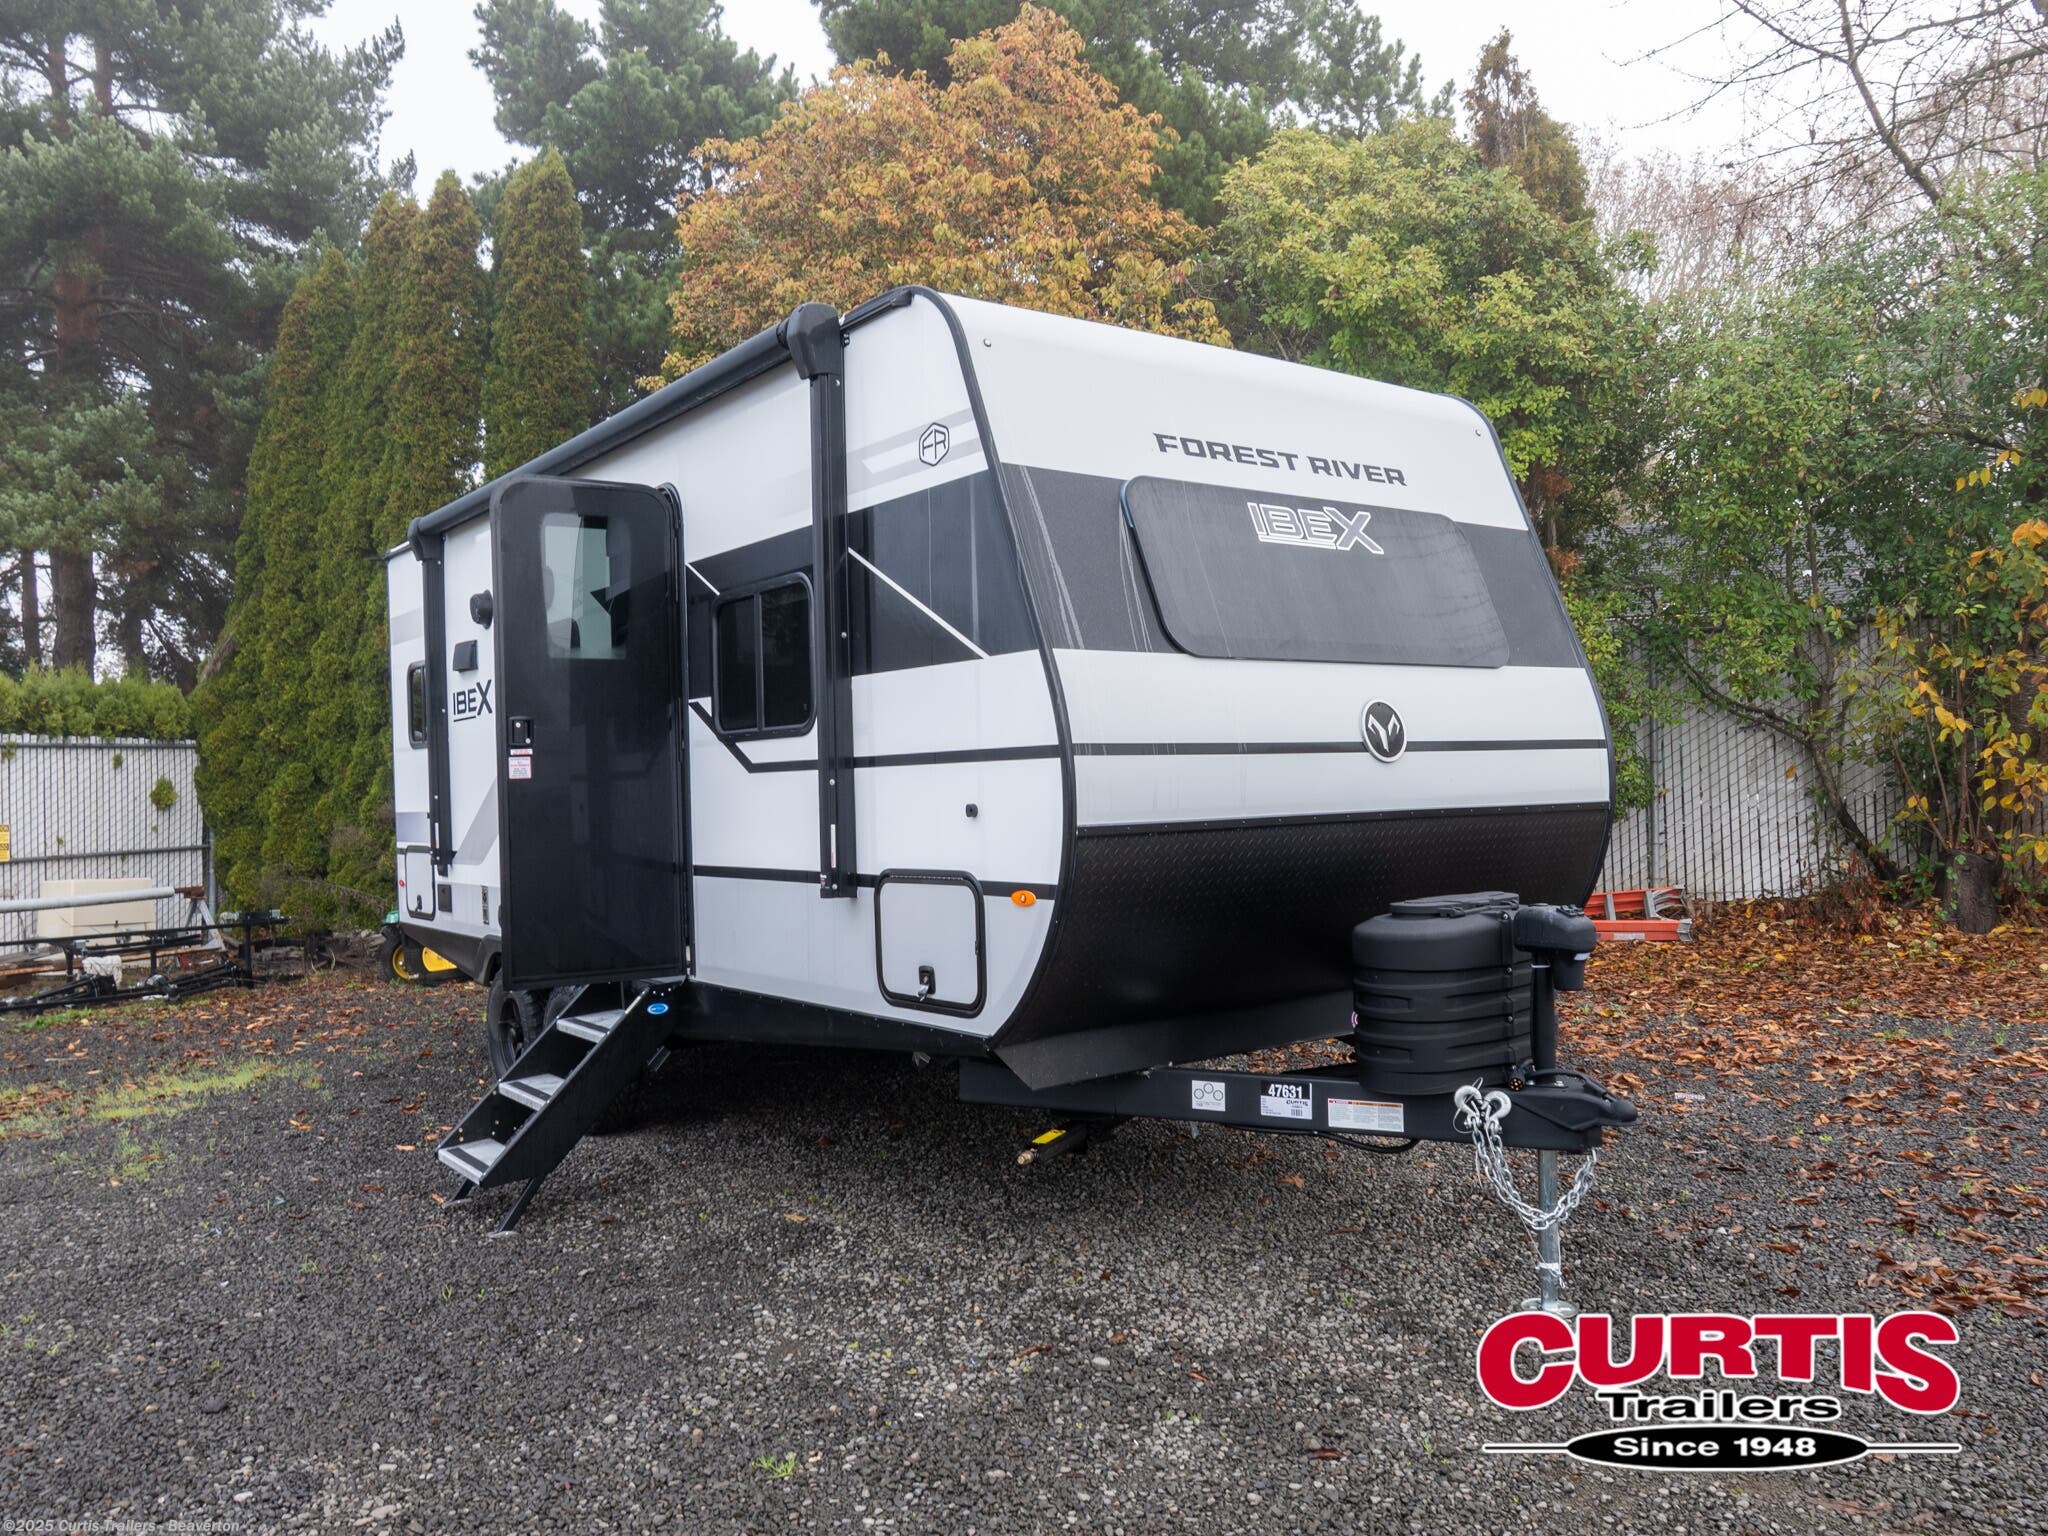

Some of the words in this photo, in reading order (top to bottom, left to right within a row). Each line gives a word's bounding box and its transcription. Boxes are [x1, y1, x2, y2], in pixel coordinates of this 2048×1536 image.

[1153, 433, 1298, 471] FOREST
[1307, 456, 1407, 486] RIVER
[1247, 502, 1384, 554] IBEX
[453, 679, 493, 719] IBEX
[1268, 1083, 1303, 1099] 47631
